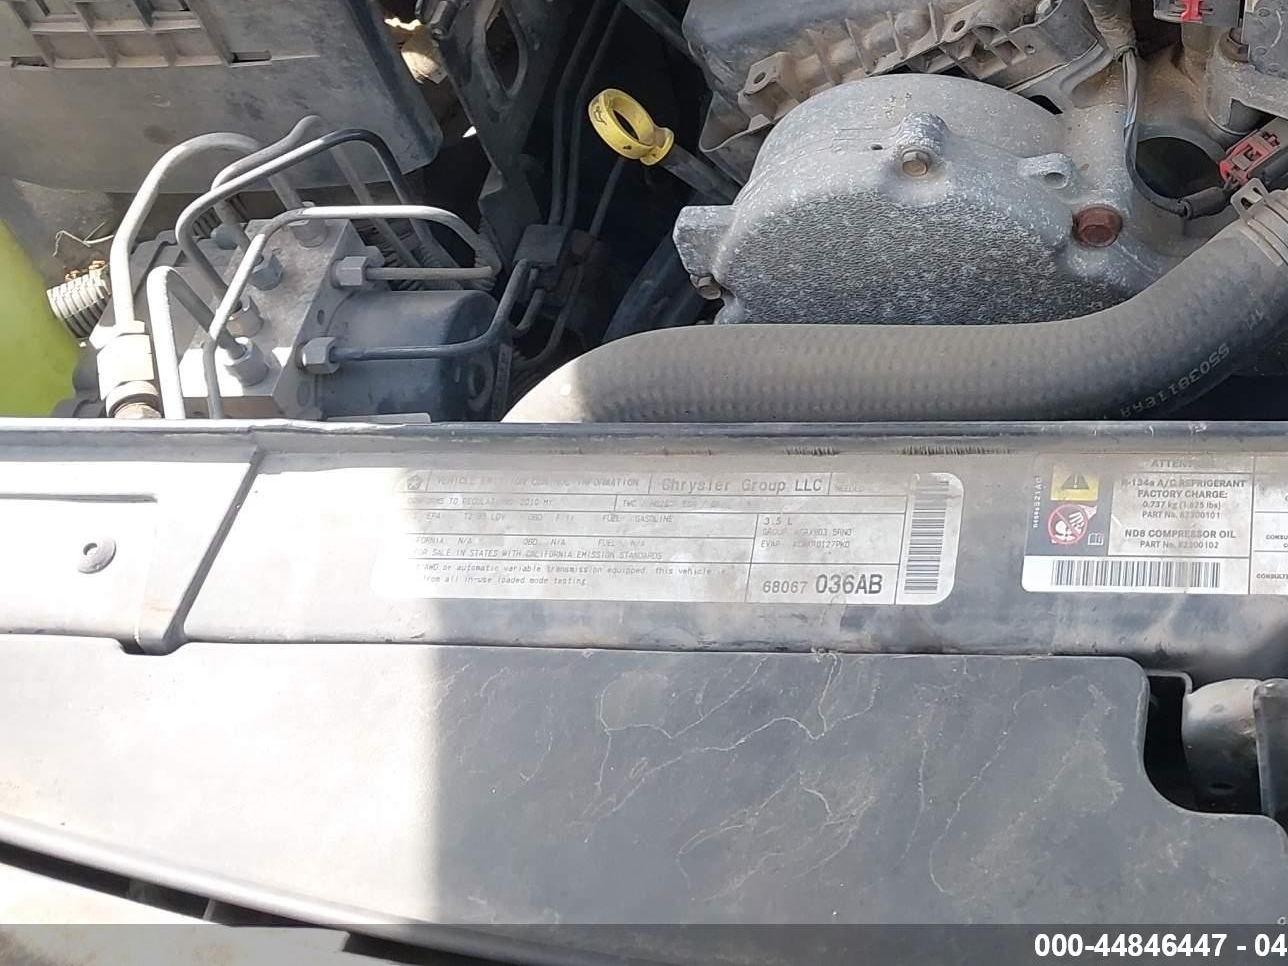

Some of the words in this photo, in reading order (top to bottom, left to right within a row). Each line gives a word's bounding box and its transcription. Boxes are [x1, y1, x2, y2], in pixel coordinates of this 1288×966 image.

[661, 478, 731, 494] Chrysler
[741, 479, 787, 495] Group
[794, 479, 823, 492] LLC
[1157, 479, 1176, 489] A/C
[1178, 479, 1246, 489] REFRIGERANT
[1136, 489, 1181, 499] FACTORY
[1183, 489, 1229, 500] CHARGE:
[448, 498, 459, 506] TO
[519, 498, 539, 507] 2010
[1142, 500, 1165, 509] 0.737
[1166, 501, 1178, 510] kg
[1205, 501, 1221, 510] lbs)
[1142, 510, 1163, 519] PART
[1164, 511, 1178, 520] No.
[635, 516, 673, 525] GASOLINE
[763, 517, 782, 526] 3.5
[1147, 529, 1218, 539] COMPRESSOR
[1219, 530, 1237, 540] OIL
[457, 537, 474, 545] N/A
[1140, 540, 1161, 549] PART
[1162, 541, 1178, 550] No.
[431, 548, 451, 557] SALE
[456, 549, 466, 557] IN
[469, 549, 498, 558] STATES
[576, 550, 615, 559] EMISSION
[456, 563, 500, 572] automatic
[503, 564, 542, 573] variable
[546, 565, 603, 574] transmission
[655, 566, 673, 575] this
[678, 567, 711, 576] vehicle
[444, 575, 458, 583] all
[496, 575, 525, 585] loaded
[529, 577, 549, 585] mode
[761, 580, 809, 595] 68067
[814, 573, 884, 596] 036AB
